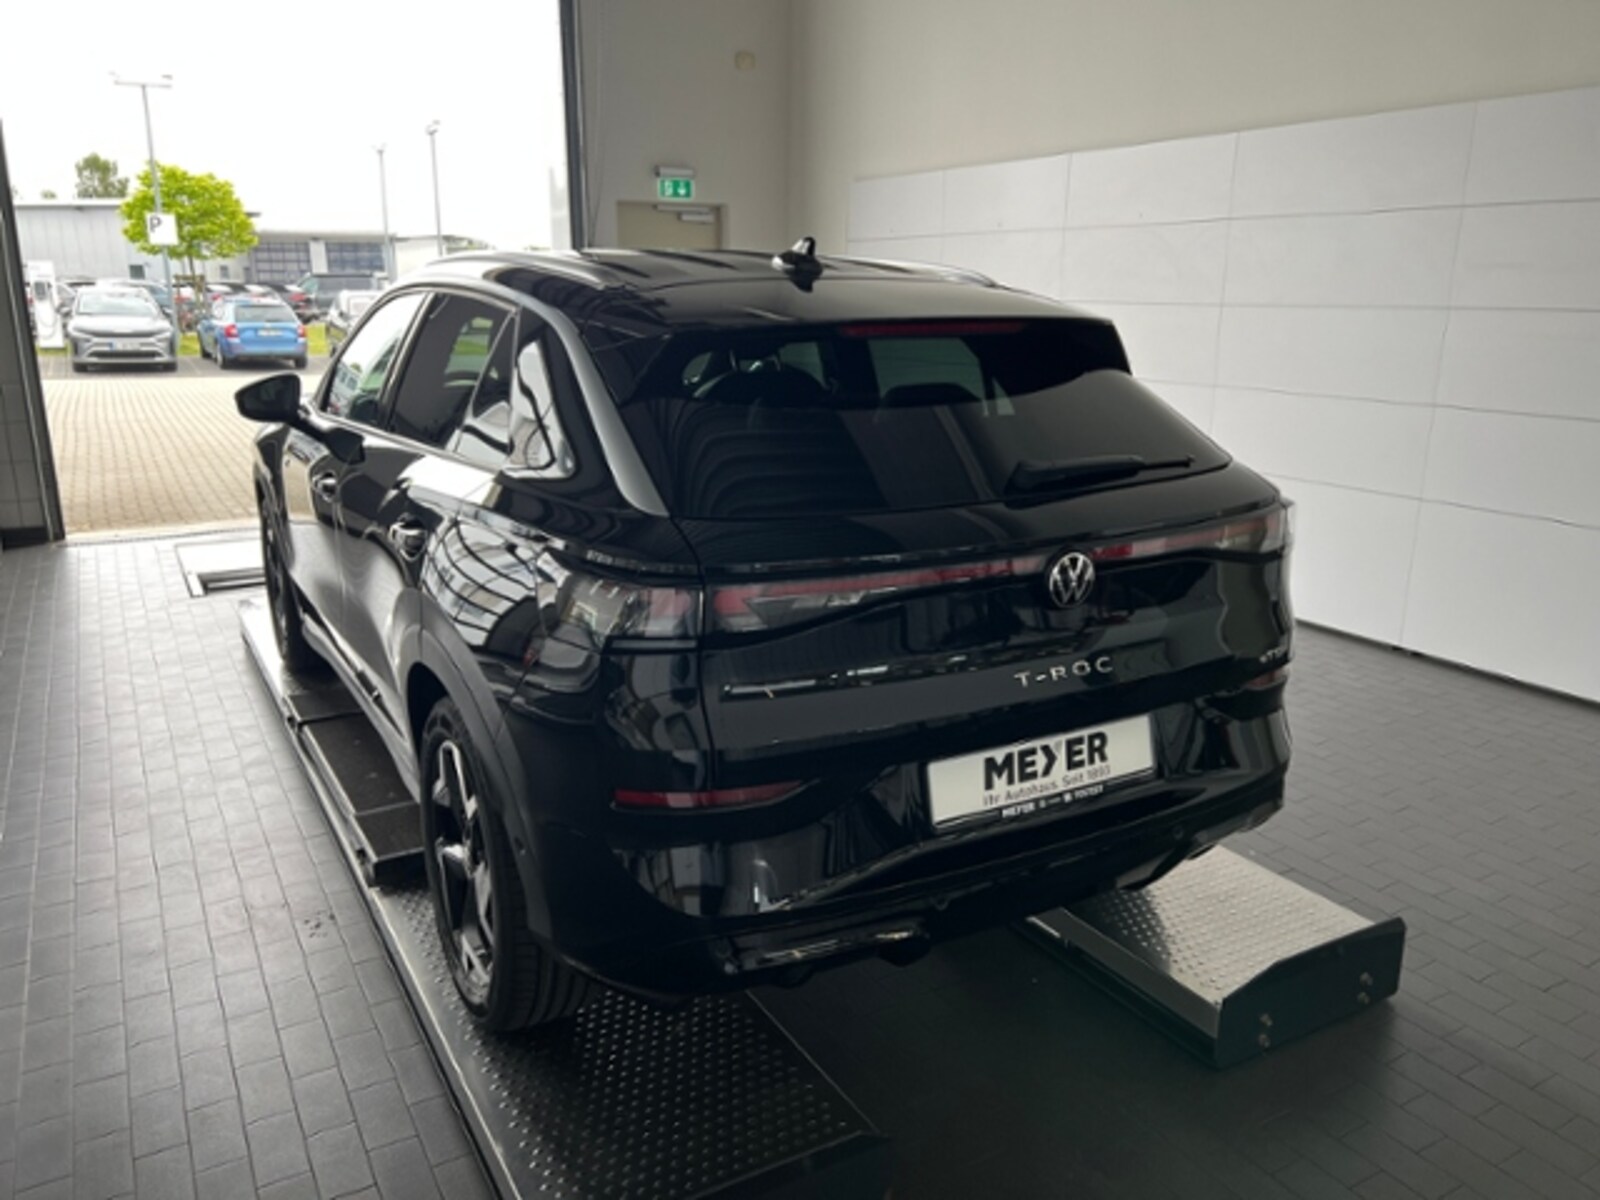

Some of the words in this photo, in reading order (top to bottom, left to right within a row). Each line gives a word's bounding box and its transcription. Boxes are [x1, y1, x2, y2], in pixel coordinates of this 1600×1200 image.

[150, 216, 162, 233] P
[1013, 656, 1113, 687] T-ROC
[984, 731, 1108, 791] MEYER
